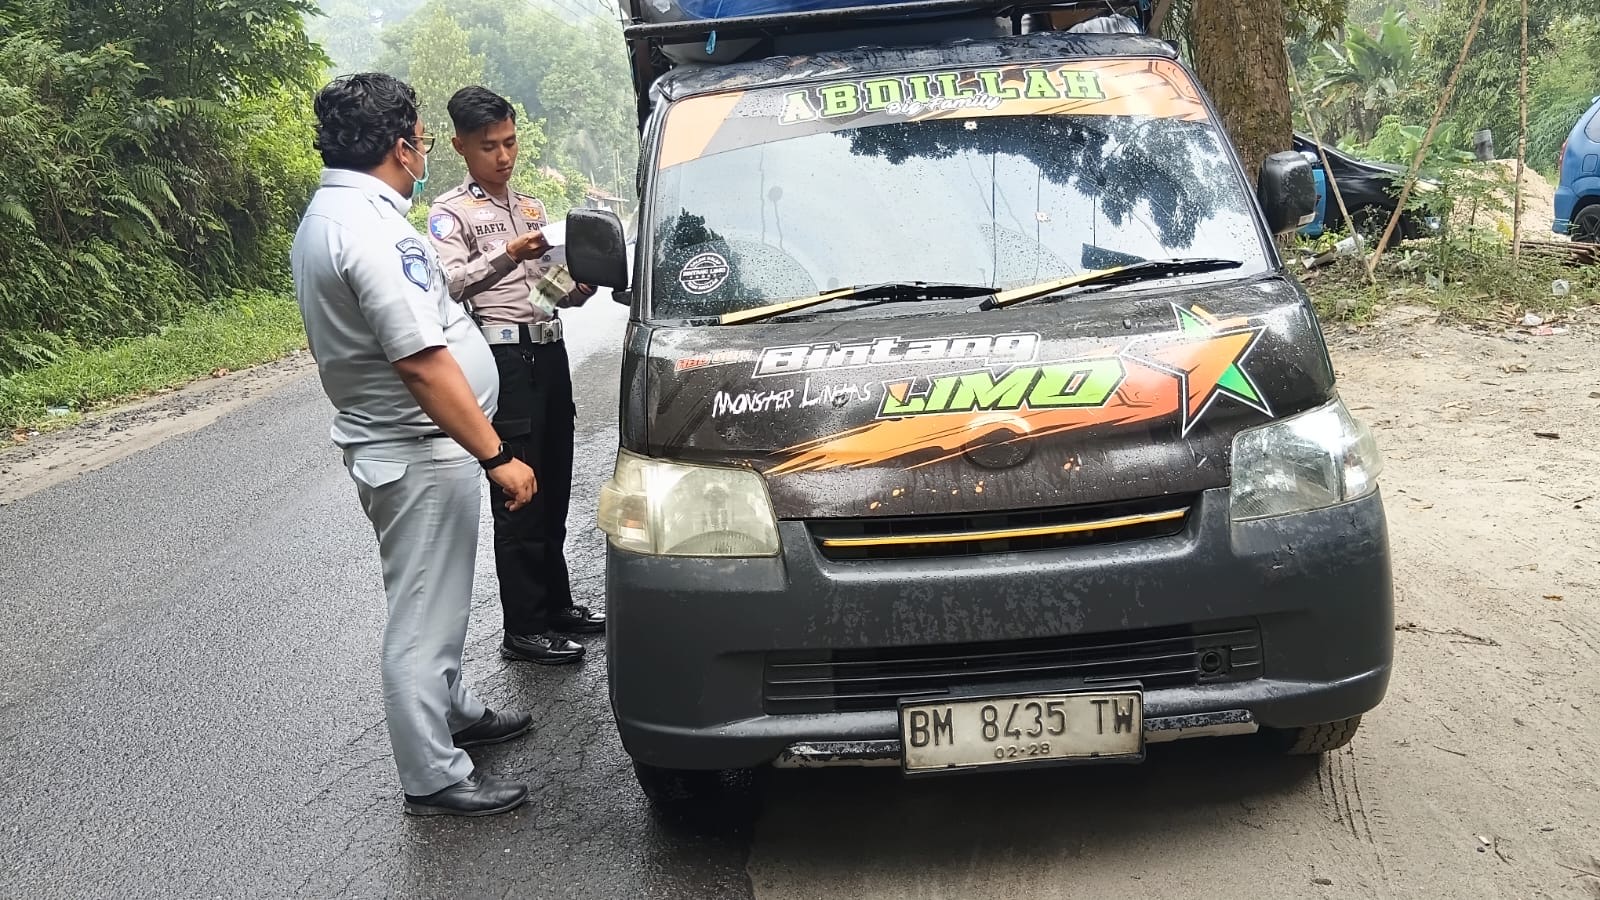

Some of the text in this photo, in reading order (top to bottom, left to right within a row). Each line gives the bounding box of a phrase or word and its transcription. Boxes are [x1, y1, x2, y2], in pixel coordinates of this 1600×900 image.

[779, 70, 1106, 124] ABDILLAH
[886, 93, 1002, 117] Big Family
[475, 223, 507, 235] HAFIZ
[755, 333, 1040, 377] Bintang
[712, 388, 795, 418] MONSTER
[878, 356, 1128, 418] LIMO
[909, 696, 1134, 748] BM 8435 TW
